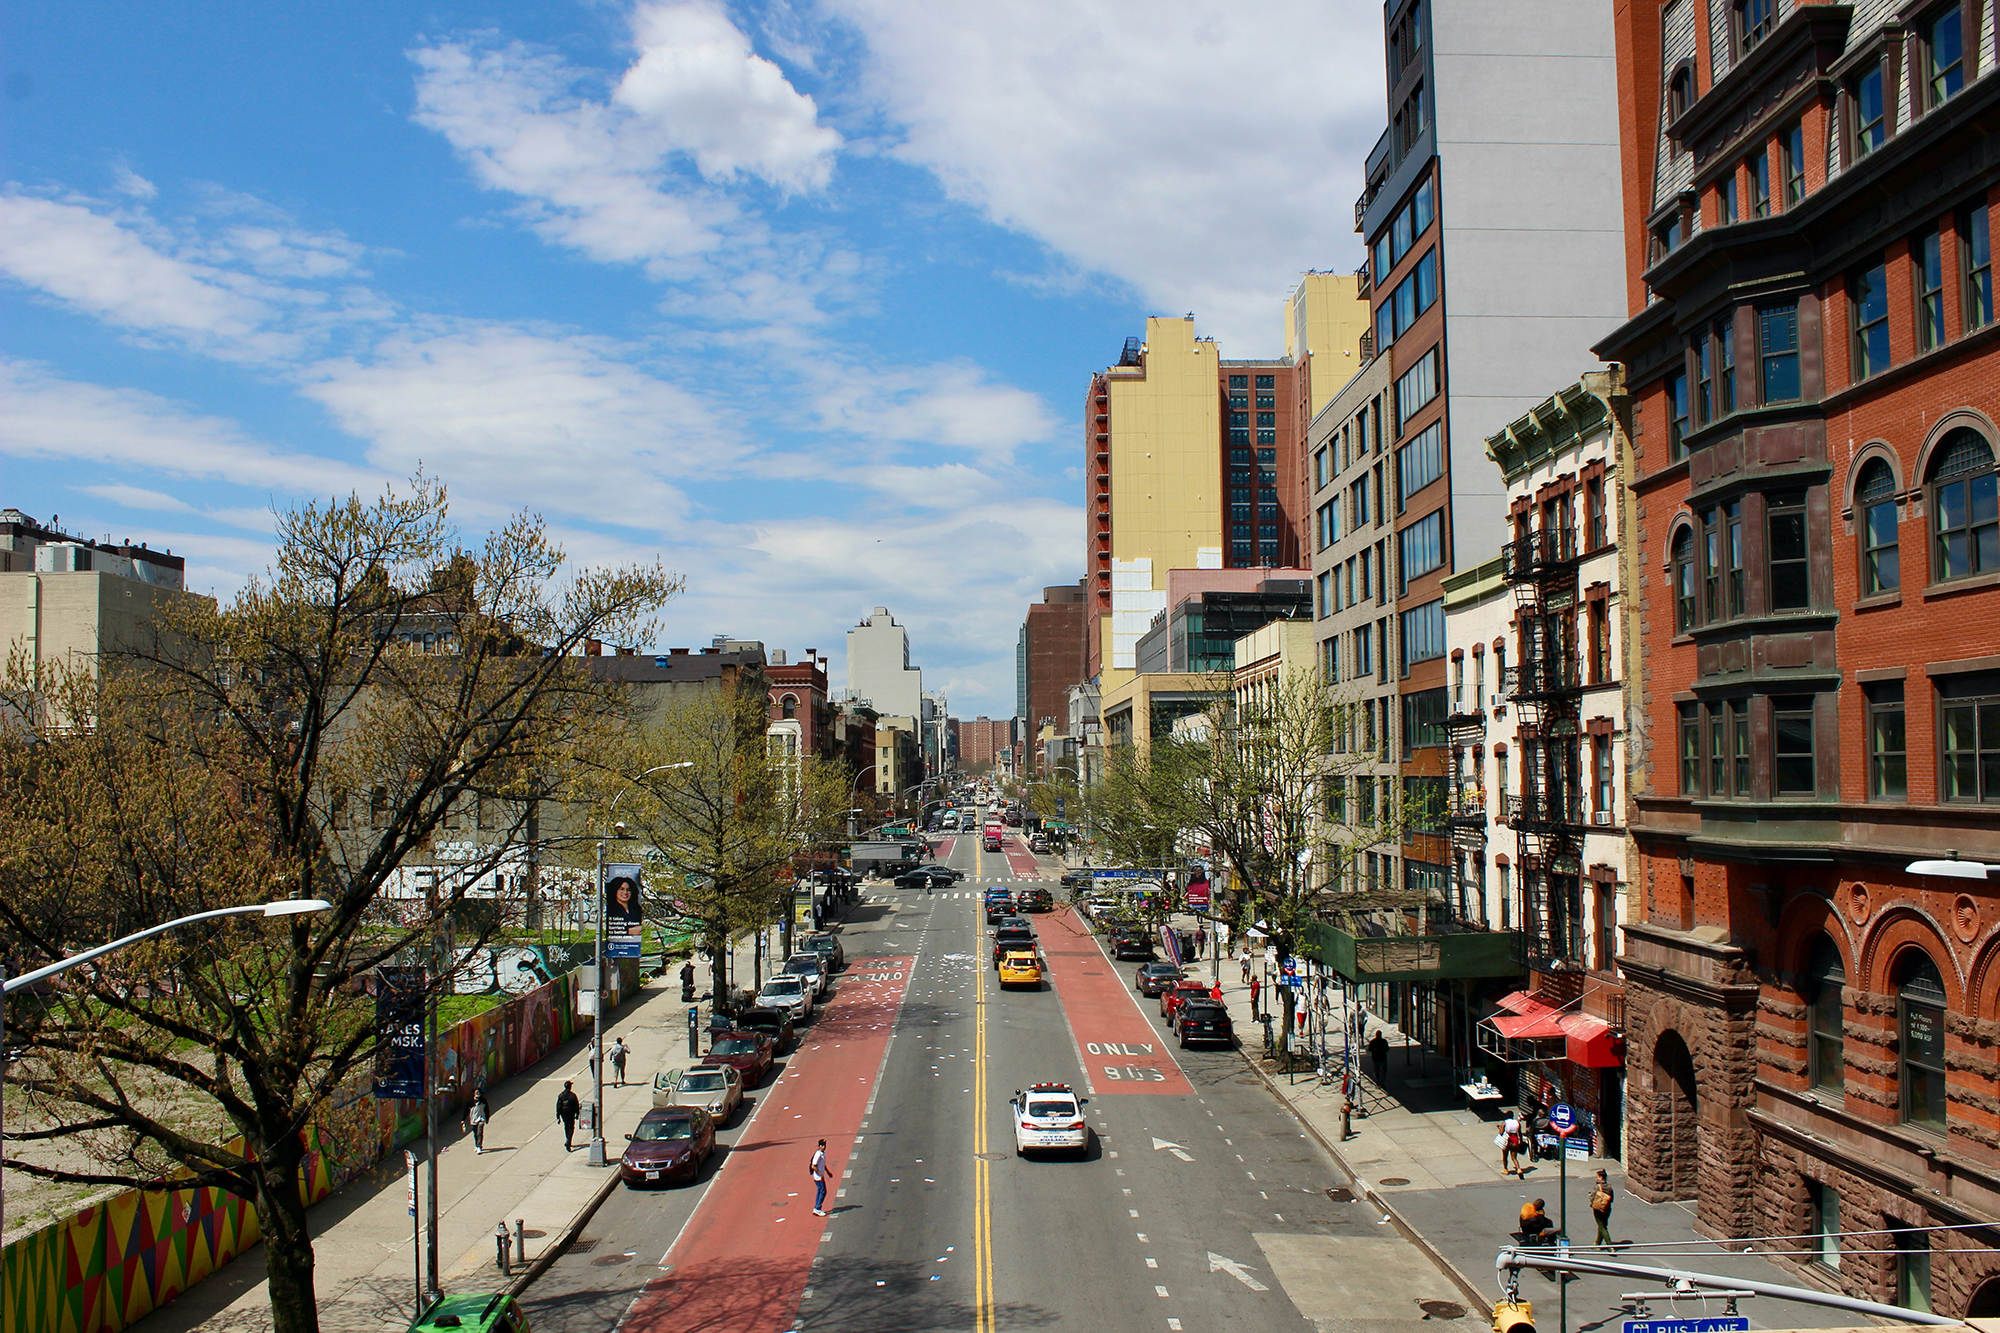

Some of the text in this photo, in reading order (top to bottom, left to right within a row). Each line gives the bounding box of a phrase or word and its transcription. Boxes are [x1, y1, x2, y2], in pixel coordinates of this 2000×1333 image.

[380, 1023, 421, 1035] AES
[391, 1035, 423, 1047] MSK.
[1086, 1042, 1153, 1056] ONLY
[1695, 1324, 1739, 1333] LANE
